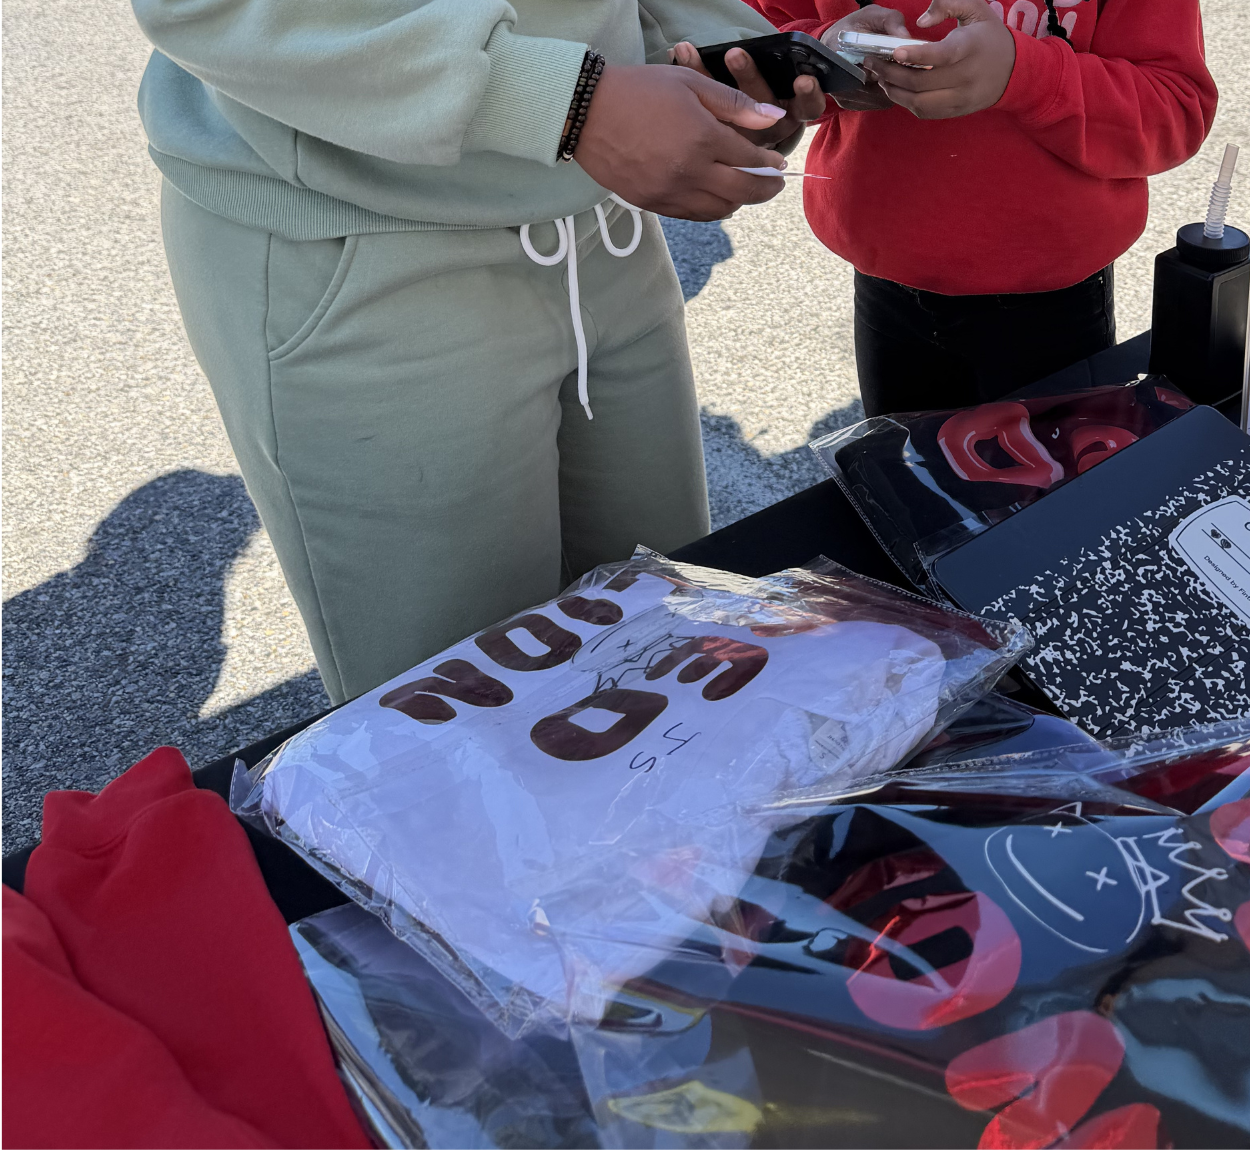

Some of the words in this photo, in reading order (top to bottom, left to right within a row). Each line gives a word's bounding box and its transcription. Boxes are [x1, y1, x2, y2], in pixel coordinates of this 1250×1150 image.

[1204, 555, 1231, 581] Designed
[1230, 578, 1239, 589] by
[378, 568, 642, 726] ION
[529, 620, 826, 762] ED
